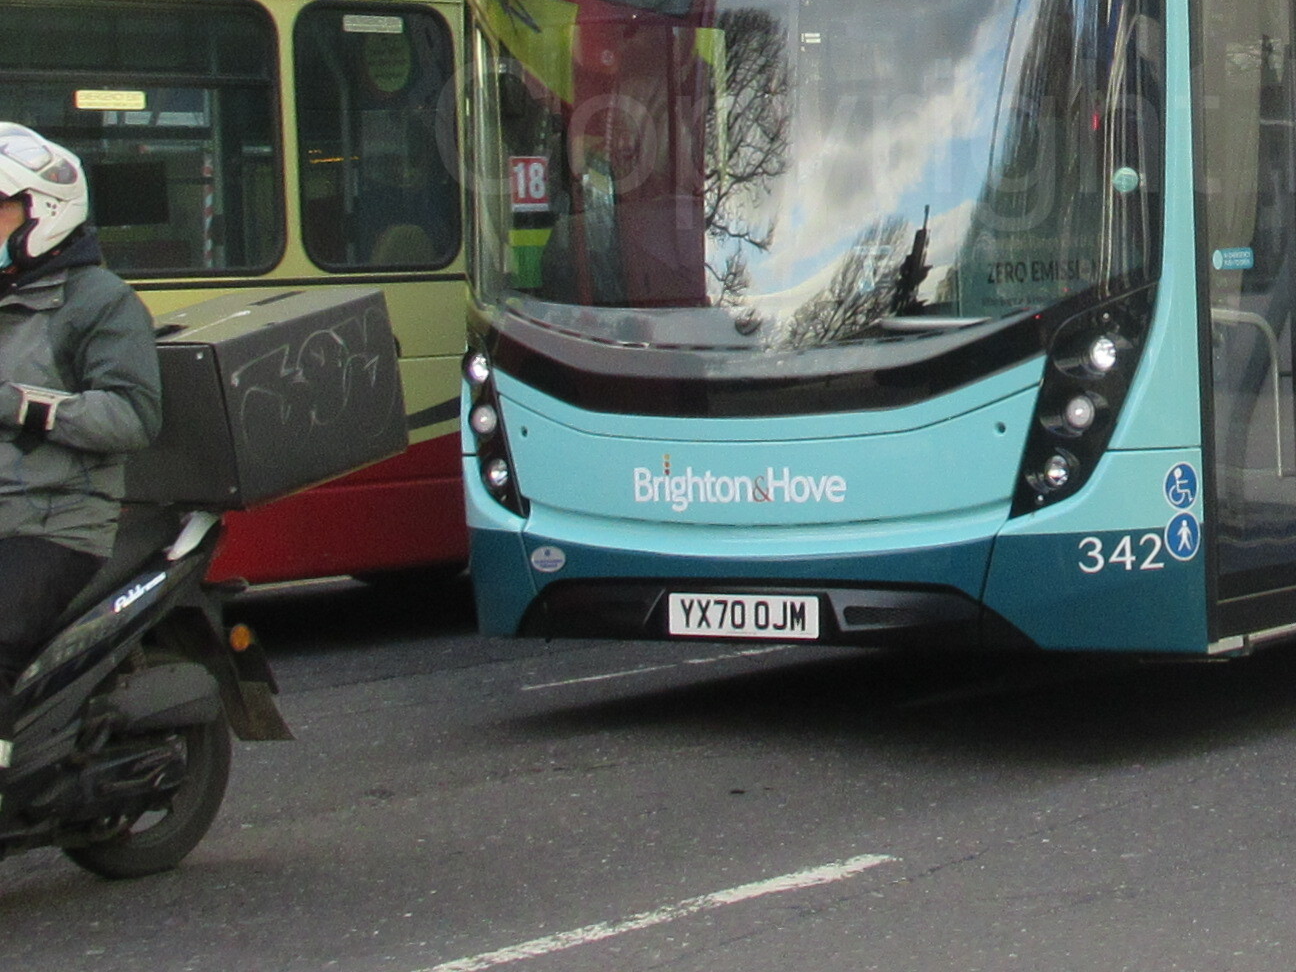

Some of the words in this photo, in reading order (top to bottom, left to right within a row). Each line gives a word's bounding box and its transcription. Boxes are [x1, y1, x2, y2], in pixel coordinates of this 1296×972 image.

[513, 162, 546, 200] 18
[987, 260, 1028, 284] ZERO
[1078, 532, 1165, 574] 342
[680, 598, 746, 630] YX70
[754, 600, 806, 632] OJM
